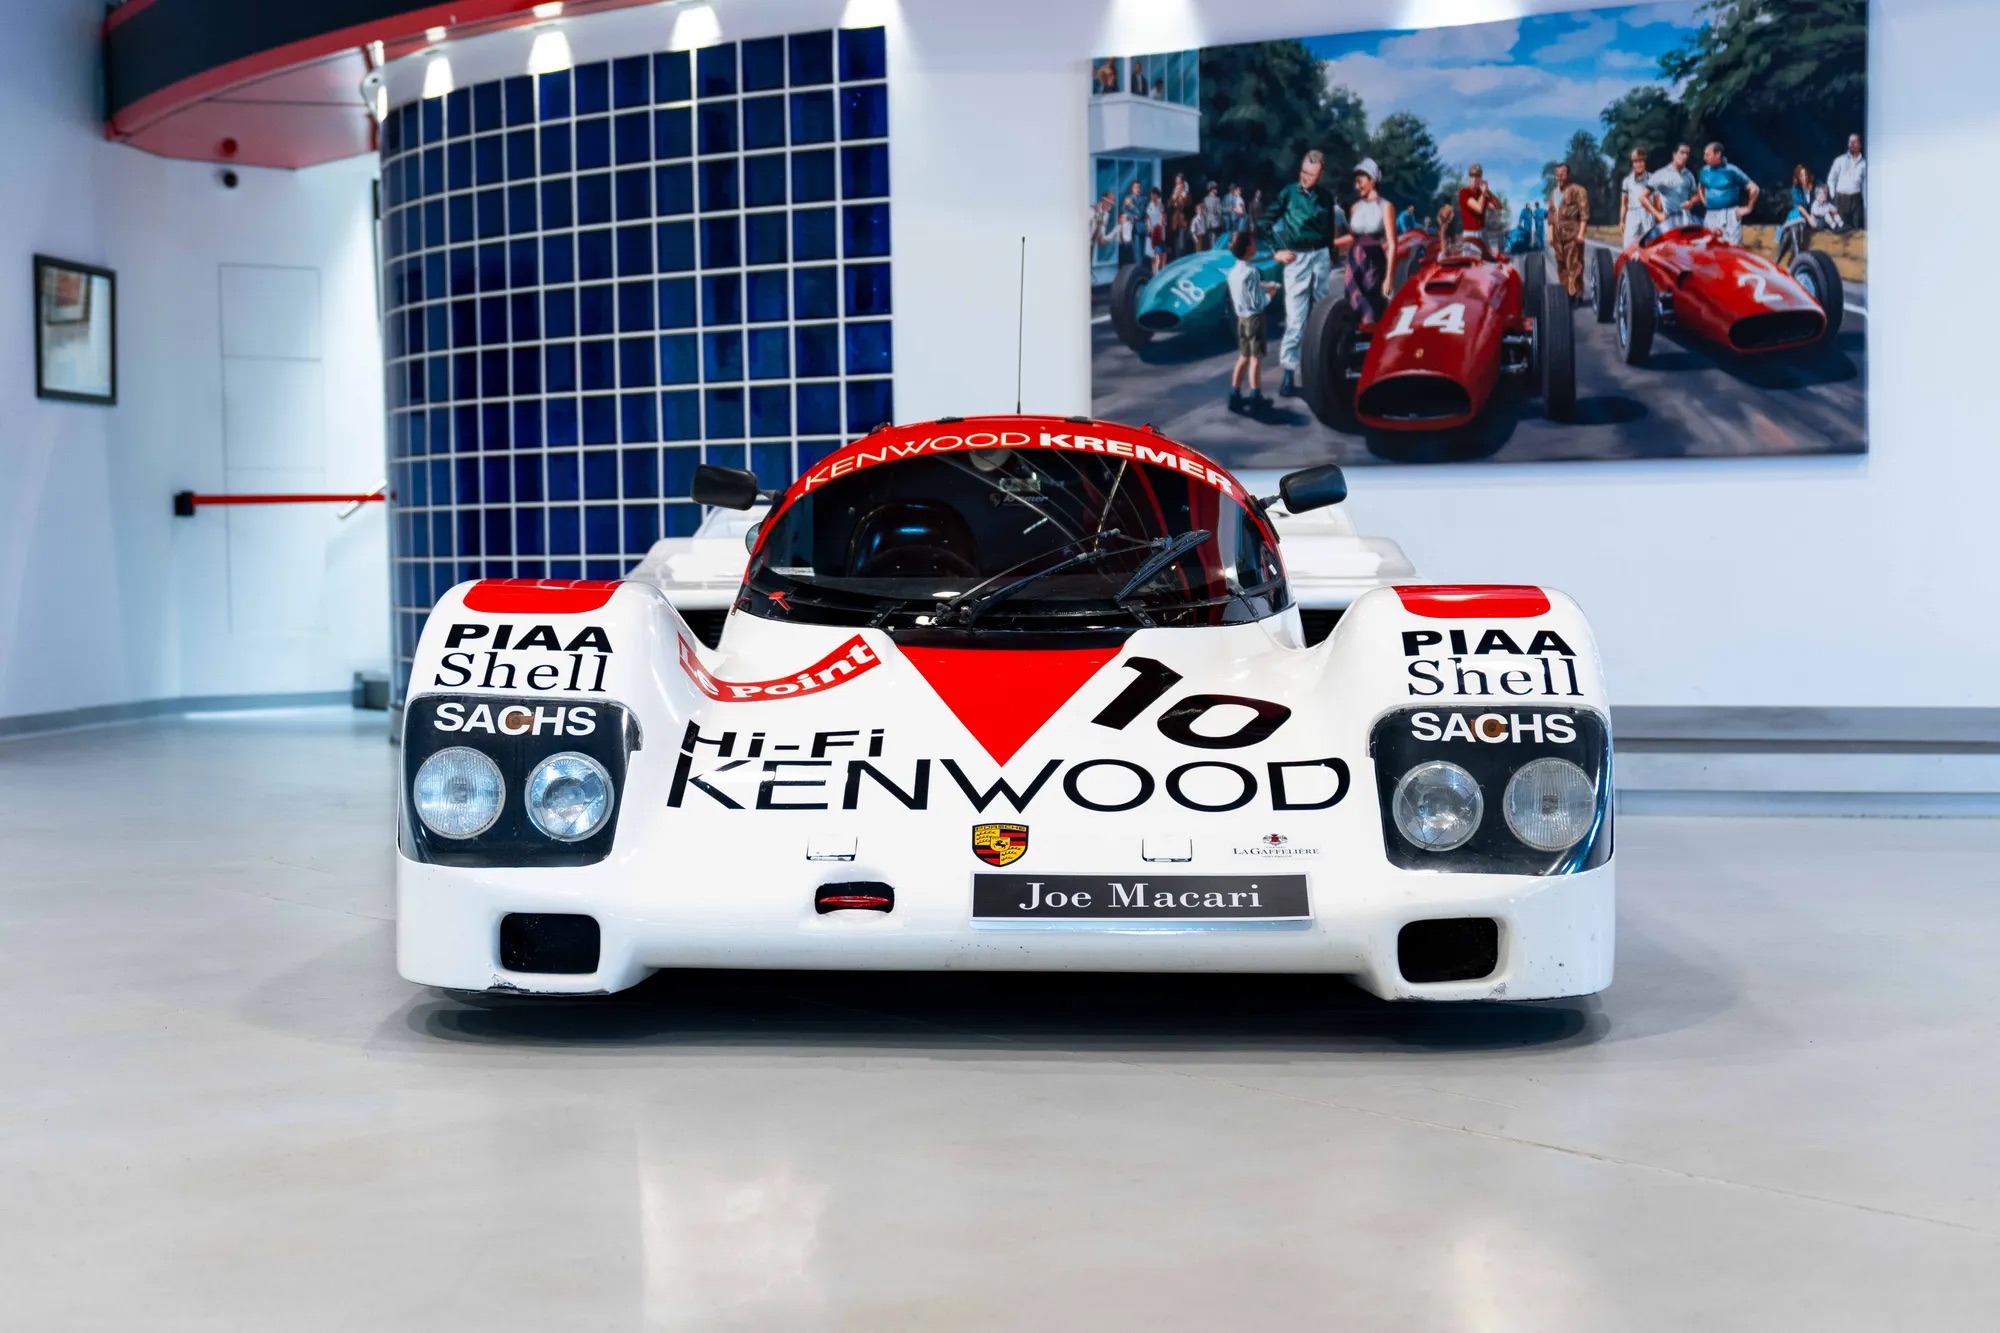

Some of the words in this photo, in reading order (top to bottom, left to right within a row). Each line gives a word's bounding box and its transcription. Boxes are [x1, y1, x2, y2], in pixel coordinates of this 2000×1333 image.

[1169, 277, 1205, 305] 18
[1737, 273, 1783, 303] 2
[1386, 302, 1466, 339] 14
[805, 432, 1031, 491] KENWOOD
[1039, 432, 1234, 496] KREMER
[444, 623, 614, 653] PIAA
[1401, 629, 1577, 657] PIAA
[434, 651, 608, 692] Shell
[726, 643, 876, 698] Point
[1407, 657, 1585, 697] Shell
[433, 702, 597, 736] SACHS
[1090, 656, 1292, 750] 10
[680, 718, 885, 758] Hi-Fi
[1410, 712, 1577, 744] SACHS
[666, 752, 1351, 814] KENWOOD
[1018, 882, 1093, 910] Joe
[1107, 883, 1263, 909] Macari
